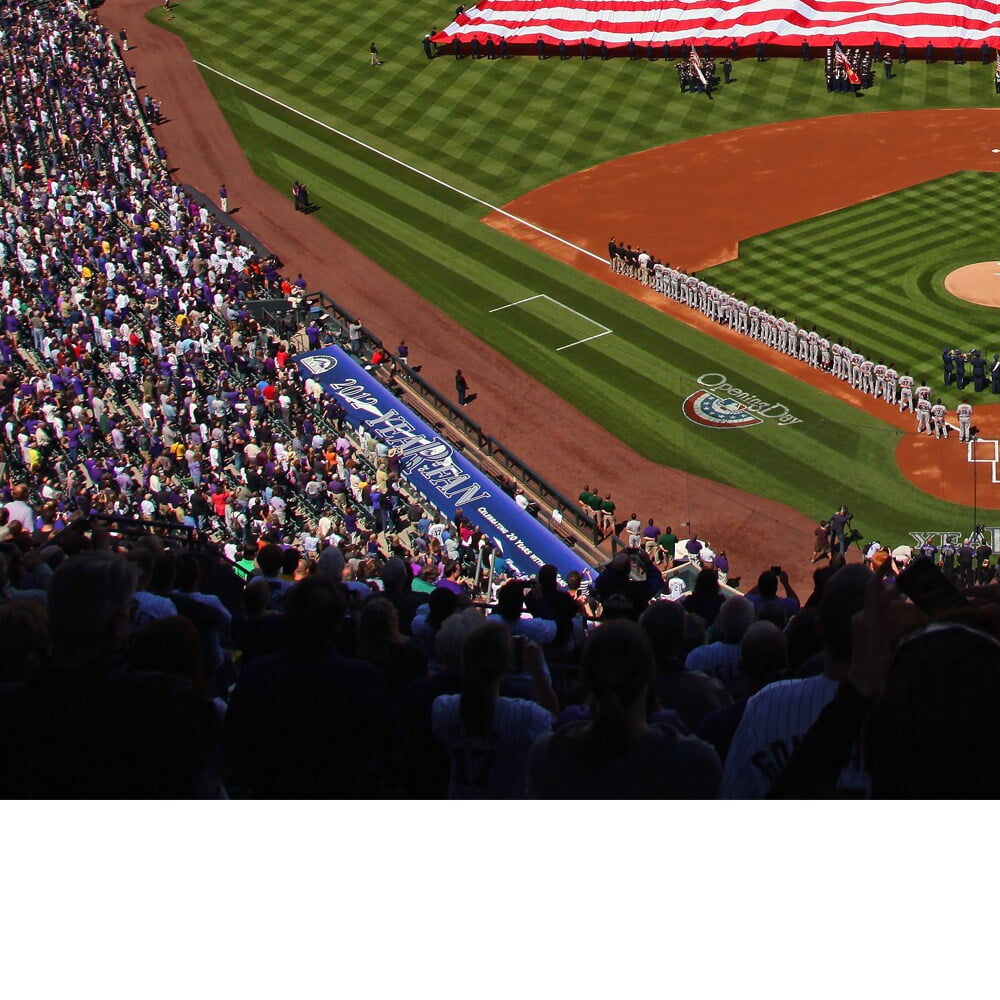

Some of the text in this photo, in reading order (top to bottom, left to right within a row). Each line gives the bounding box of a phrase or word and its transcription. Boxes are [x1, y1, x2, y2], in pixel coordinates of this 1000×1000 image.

[329, 378, 492, 507] 2012 YEAR FAN
[477, 507, 546, 568] CELEBRATING 20 YEARS WITH
